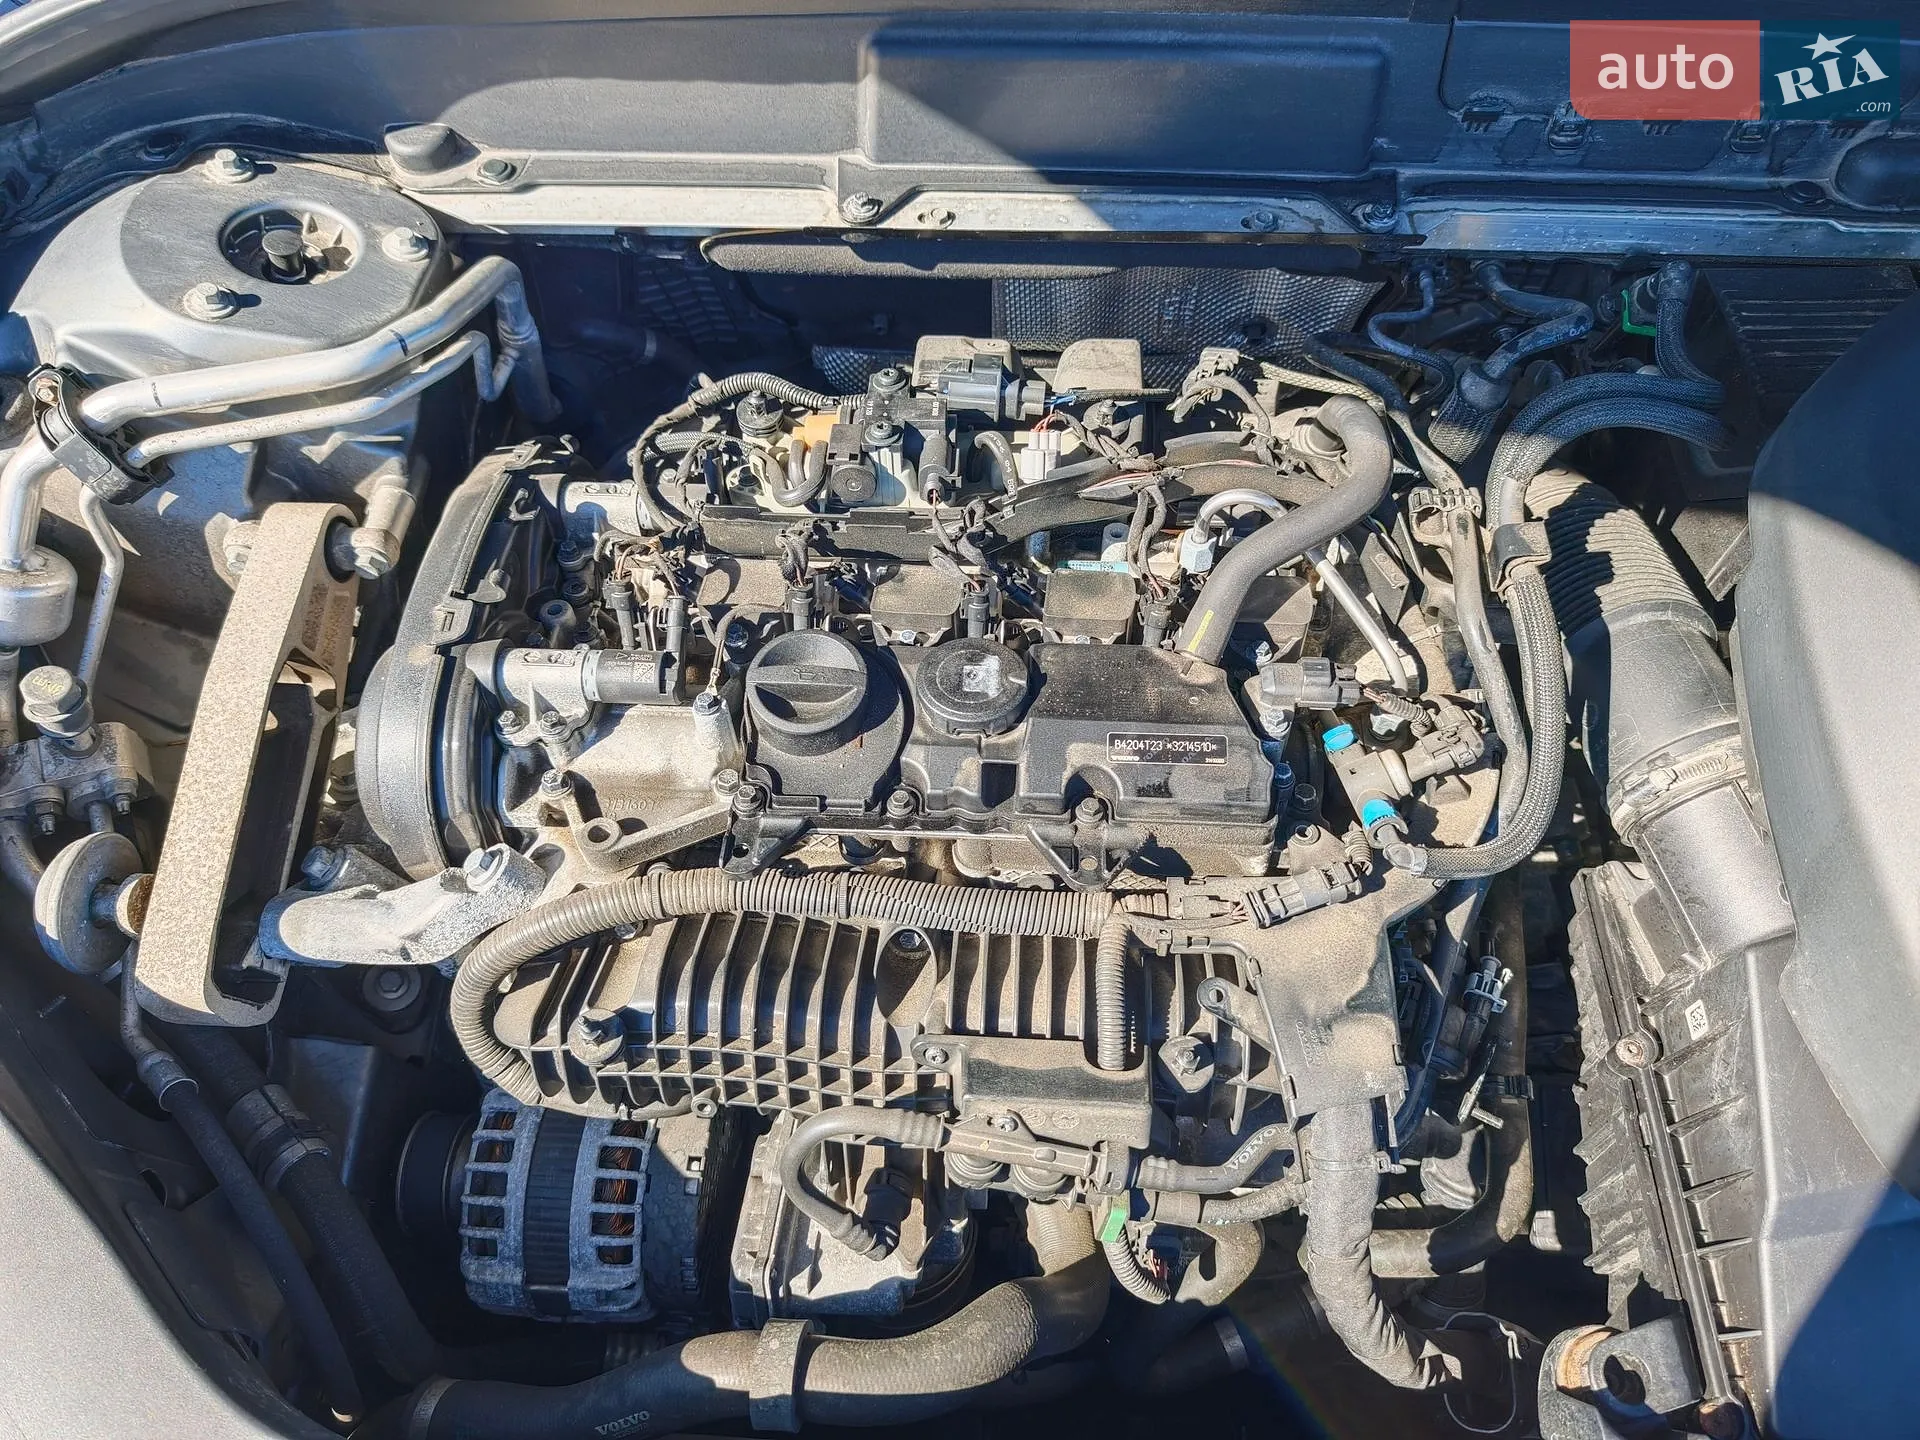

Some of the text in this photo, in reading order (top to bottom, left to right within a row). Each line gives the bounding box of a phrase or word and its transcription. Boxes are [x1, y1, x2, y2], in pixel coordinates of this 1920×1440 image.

[1113, 739, 1163, 751] B4204T23
[1226, 1127, 1277, 1170] VOLVO
[594, 1410, 650, 1436] VOLVO
